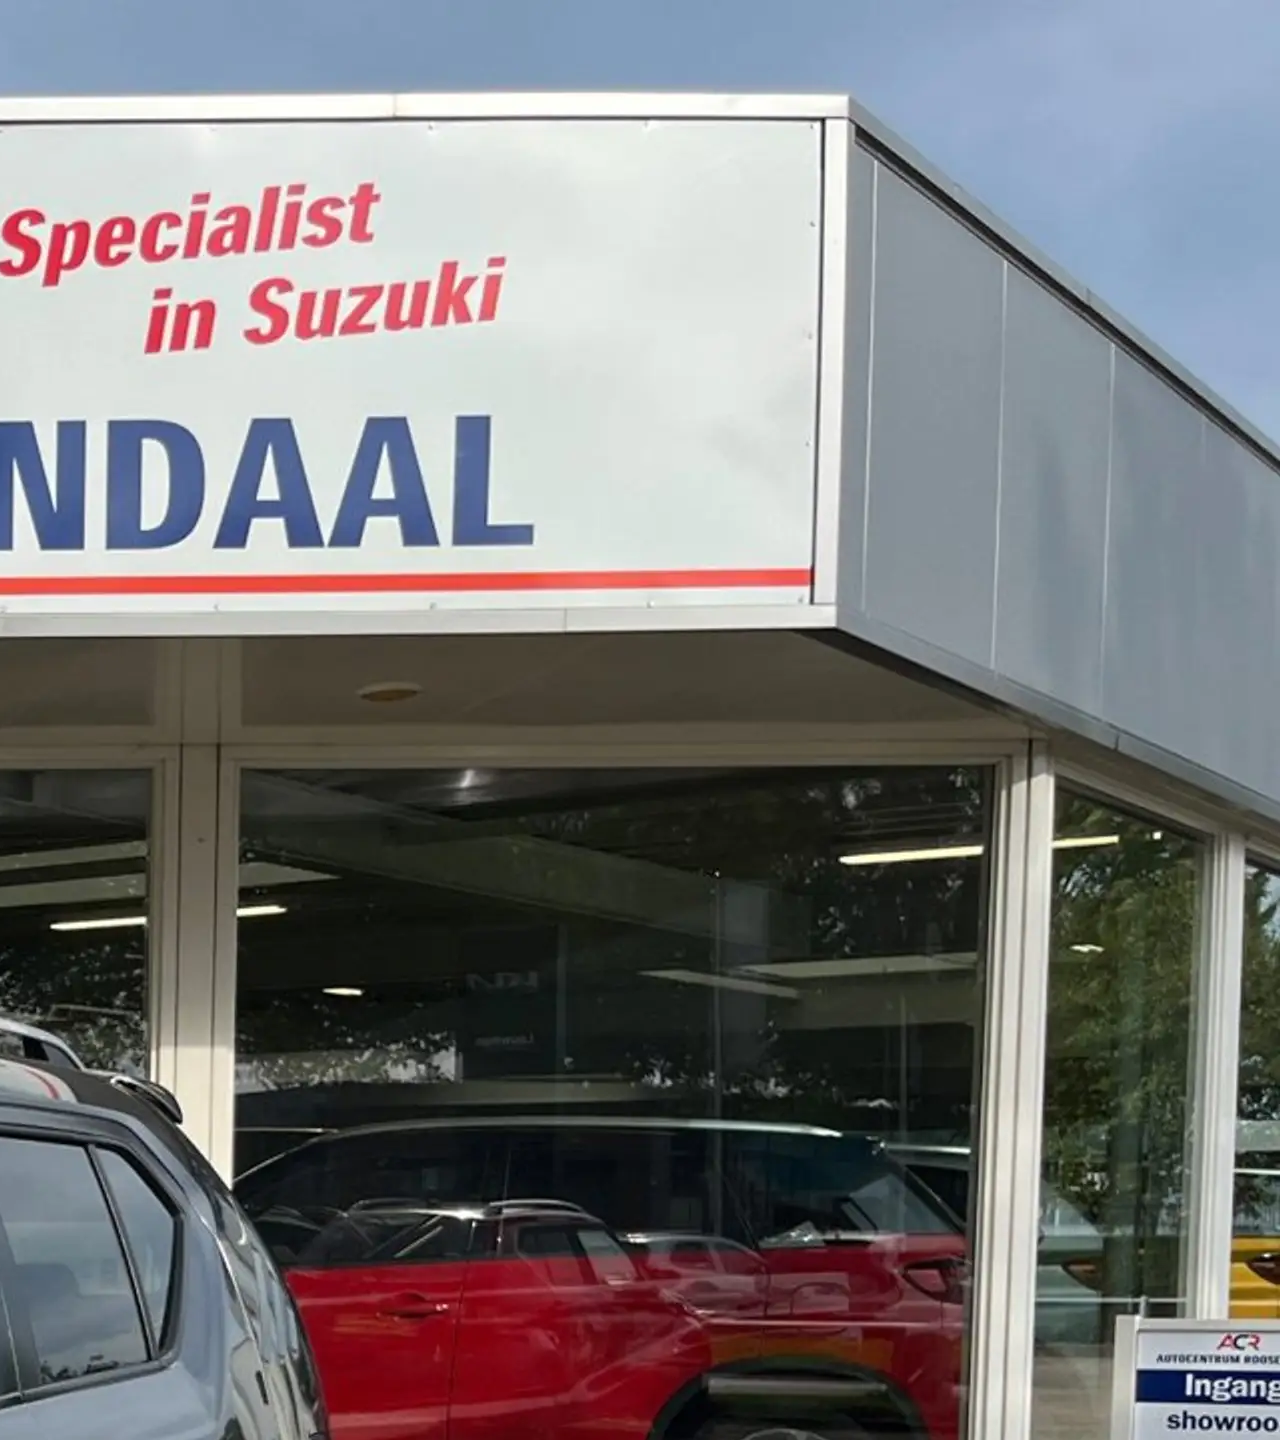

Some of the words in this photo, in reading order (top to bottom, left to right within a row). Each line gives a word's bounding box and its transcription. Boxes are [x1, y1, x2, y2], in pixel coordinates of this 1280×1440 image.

[144, 288, 217, 355] in
[243, 256, 507, 346] Suzuki
[1217, 1334, 1262, 1351] ACR
[1156, 1354, 1241, 1364] AUTOCENTRUM
